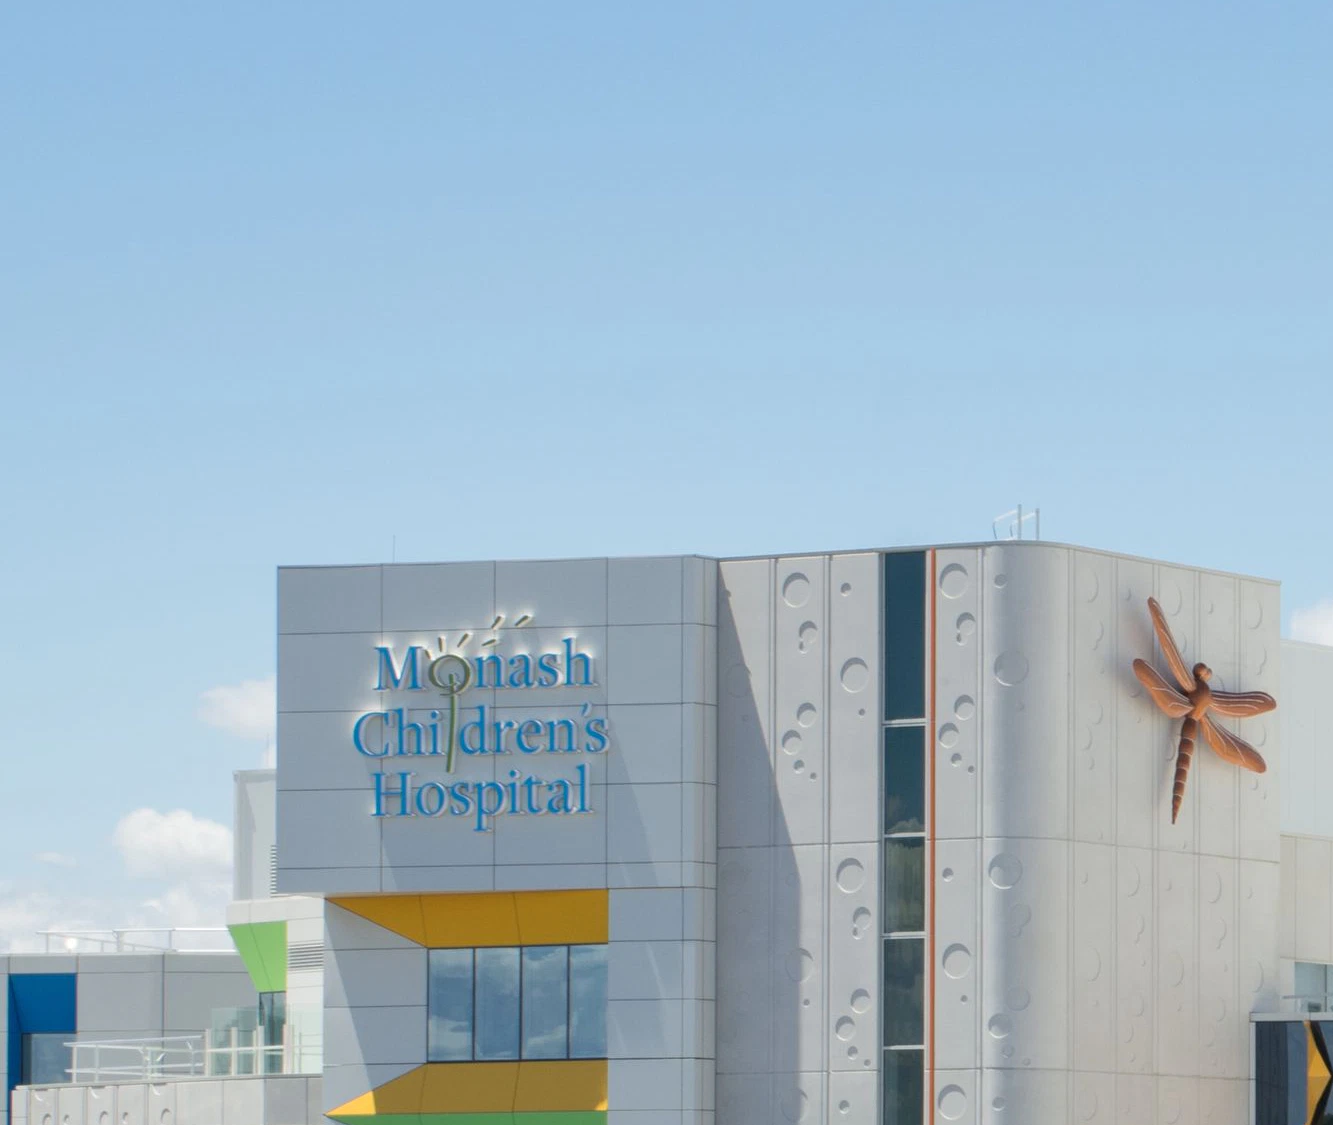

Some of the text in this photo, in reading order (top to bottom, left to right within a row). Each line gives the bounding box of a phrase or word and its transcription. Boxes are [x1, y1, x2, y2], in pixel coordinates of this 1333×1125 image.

[373, 637, 597, 696] Monash
[353, 702, 610, 760] Children's
[371, 763, 594, 832] Hospital
